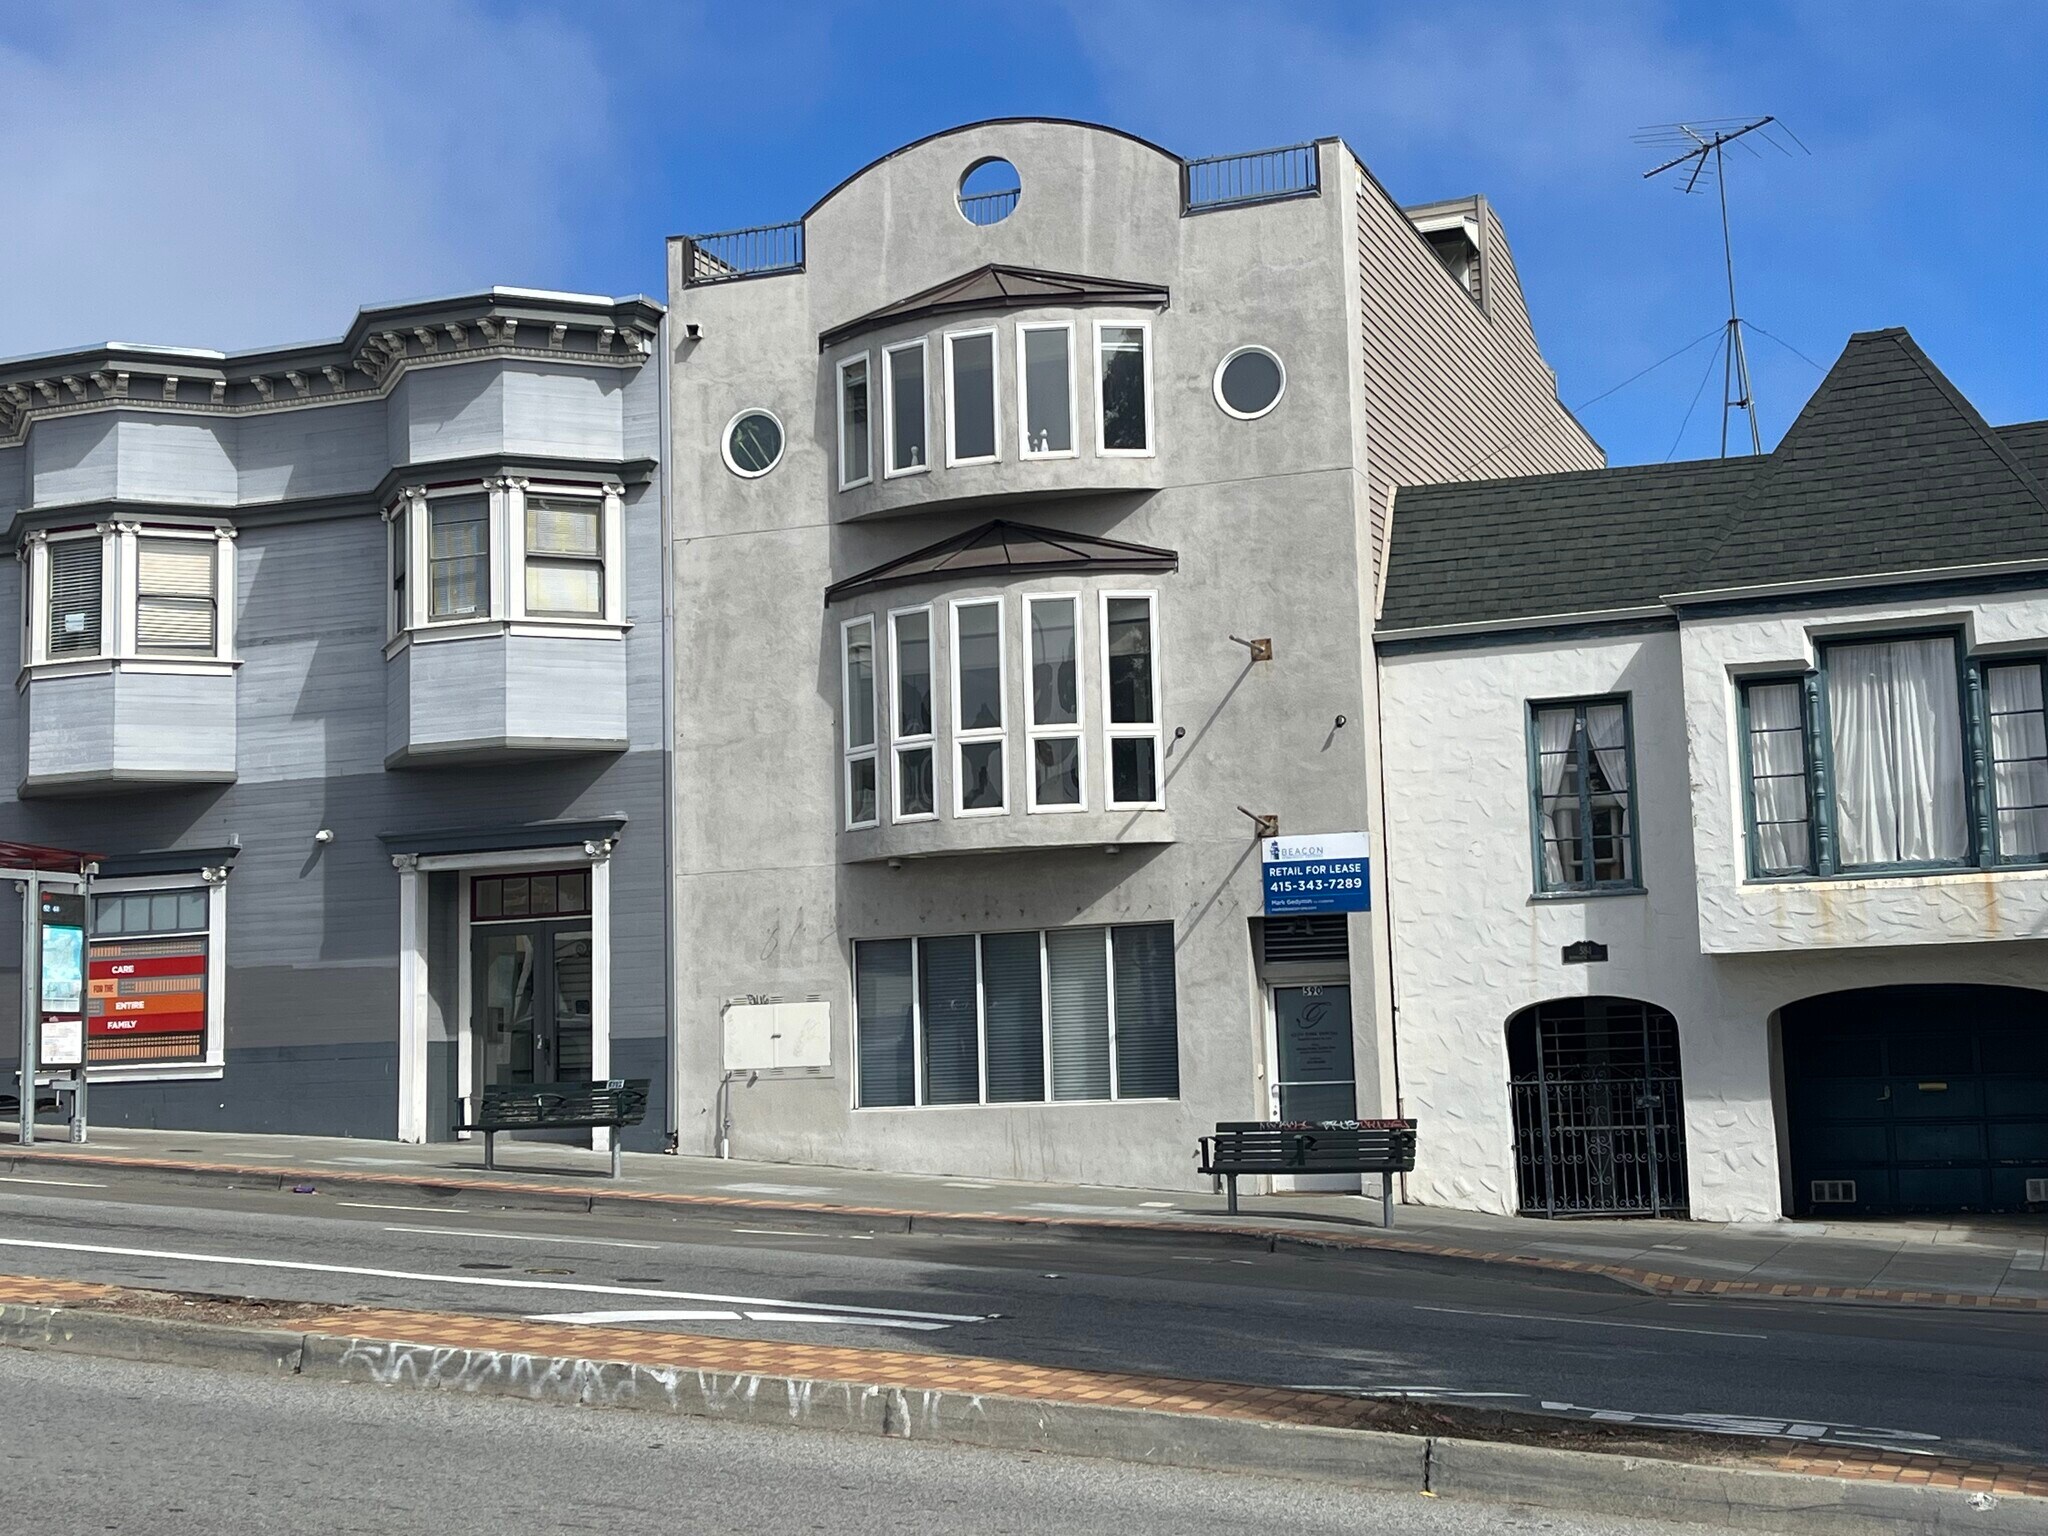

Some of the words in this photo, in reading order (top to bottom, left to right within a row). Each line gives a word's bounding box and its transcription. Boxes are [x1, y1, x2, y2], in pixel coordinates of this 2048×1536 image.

[1281, 847, 1324, 856] BEACON
[1269, 867, 1304, 877] RETAIL
[1306, 865, 1326, 875] FOR
[1329, 863, 1362, 874] LEASE
[1270, 878, 1362, 892] 415-343-7289
[111, 965, 135, 974] CARE
[93, 985, 103, 993] FOR
[104, 984, 114, 993] THE
[1304, 986, 1322, 995] 590
[115, 1000, 145, 1010] ENTIRE
[107, 1020, 138, 1030] FAMILY
